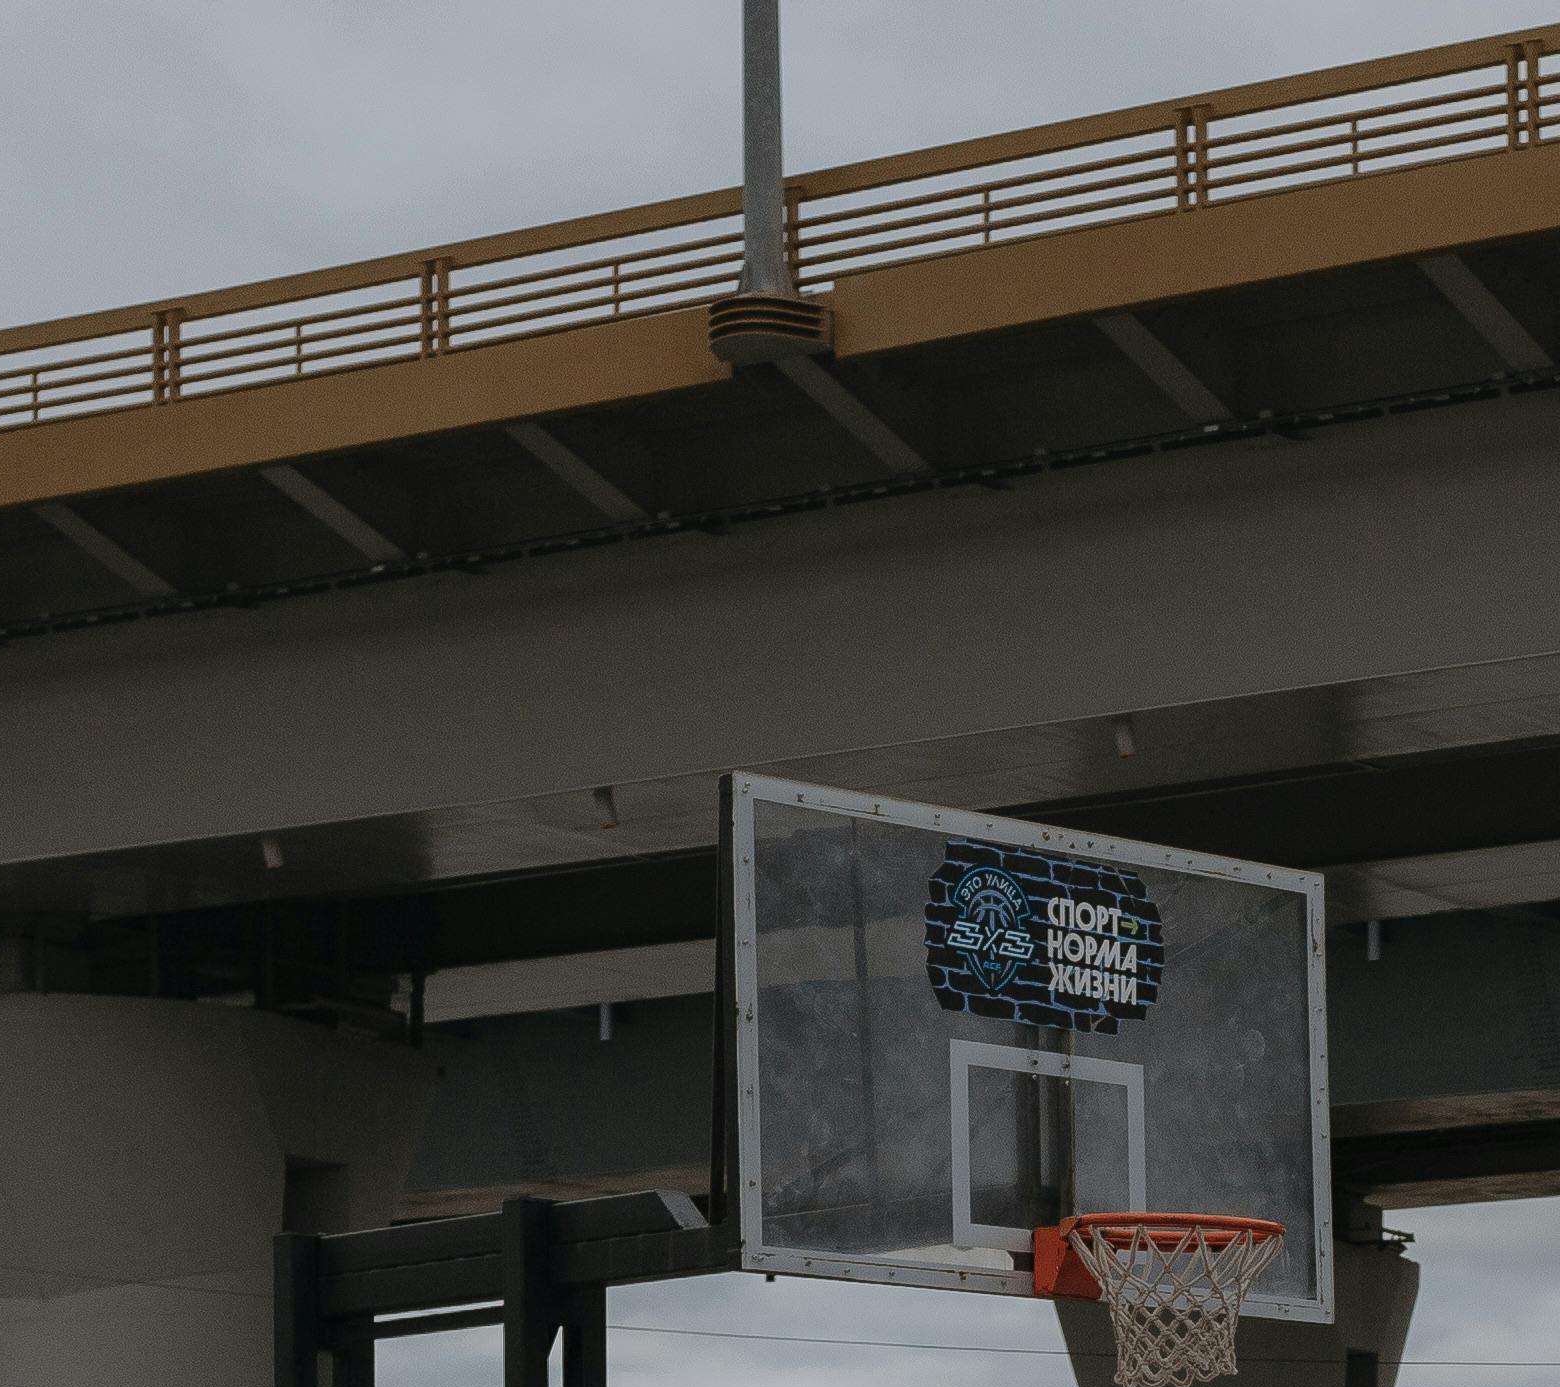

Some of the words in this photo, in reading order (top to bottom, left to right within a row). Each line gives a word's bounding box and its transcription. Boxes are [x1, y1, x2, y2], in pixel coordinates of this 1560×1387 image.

[960, 876, 982, 901] ЭТО
[985, 873, 1022, 911] УЛИЦА
[1047, 896, 1122, 937] СПОРТ
[1047, 928, 1138, 973] НОРМА
[1047, 961, 1138, 1006] ЖИЗНИ
